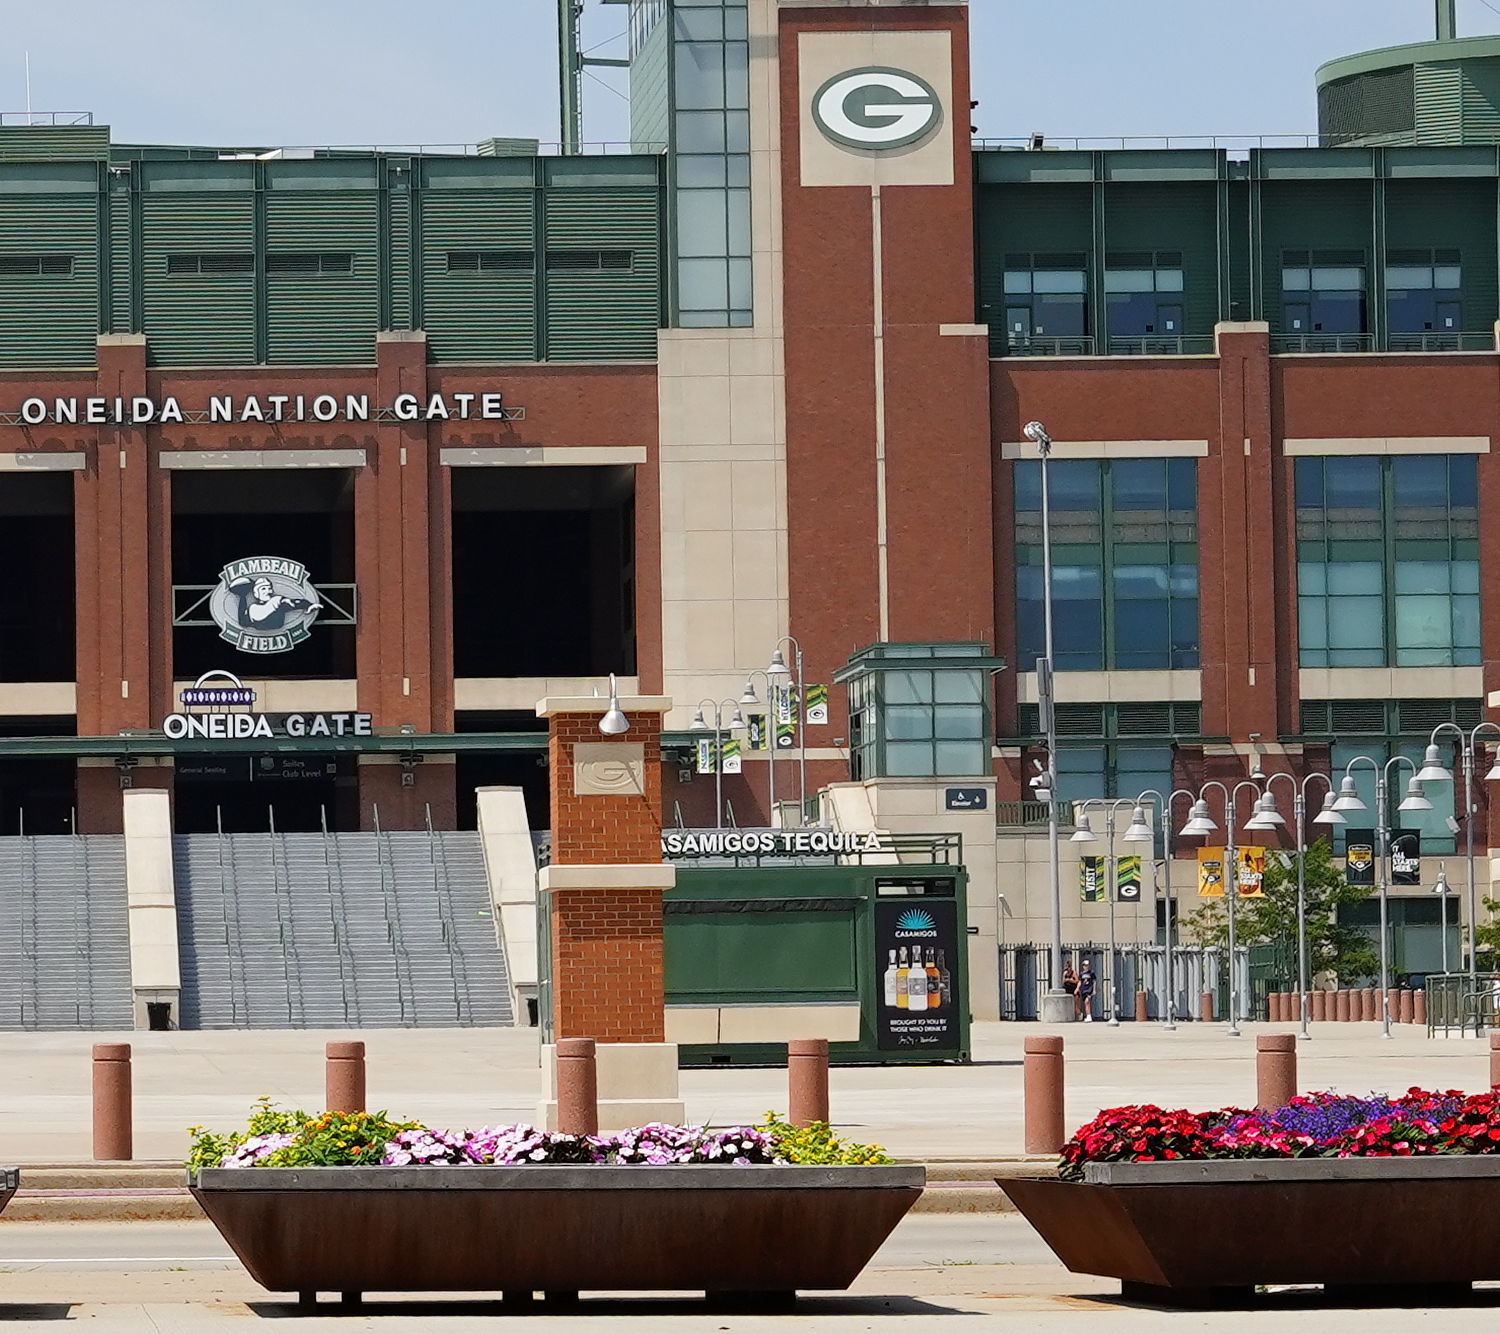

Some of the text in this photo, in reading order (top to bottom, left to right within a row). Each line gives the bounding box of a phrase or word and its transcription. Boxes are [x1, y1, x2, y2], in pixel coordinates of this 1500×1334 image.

[817, 72, 934, 143] G
[21, 393, 502, 424] ONEIDA NATION GATE
[227, 559, 301, 580] LAMBEAU
[242, 635, 287, 651] FIELD
[163, 714, 372, 739] ONEIDA GATE
[661, 831, 881, 853] SAMIGOS TEQUILA
[1086, 868, 1095, 891] VISIT
[895, 930, 937, 938] CASAMIGOS
